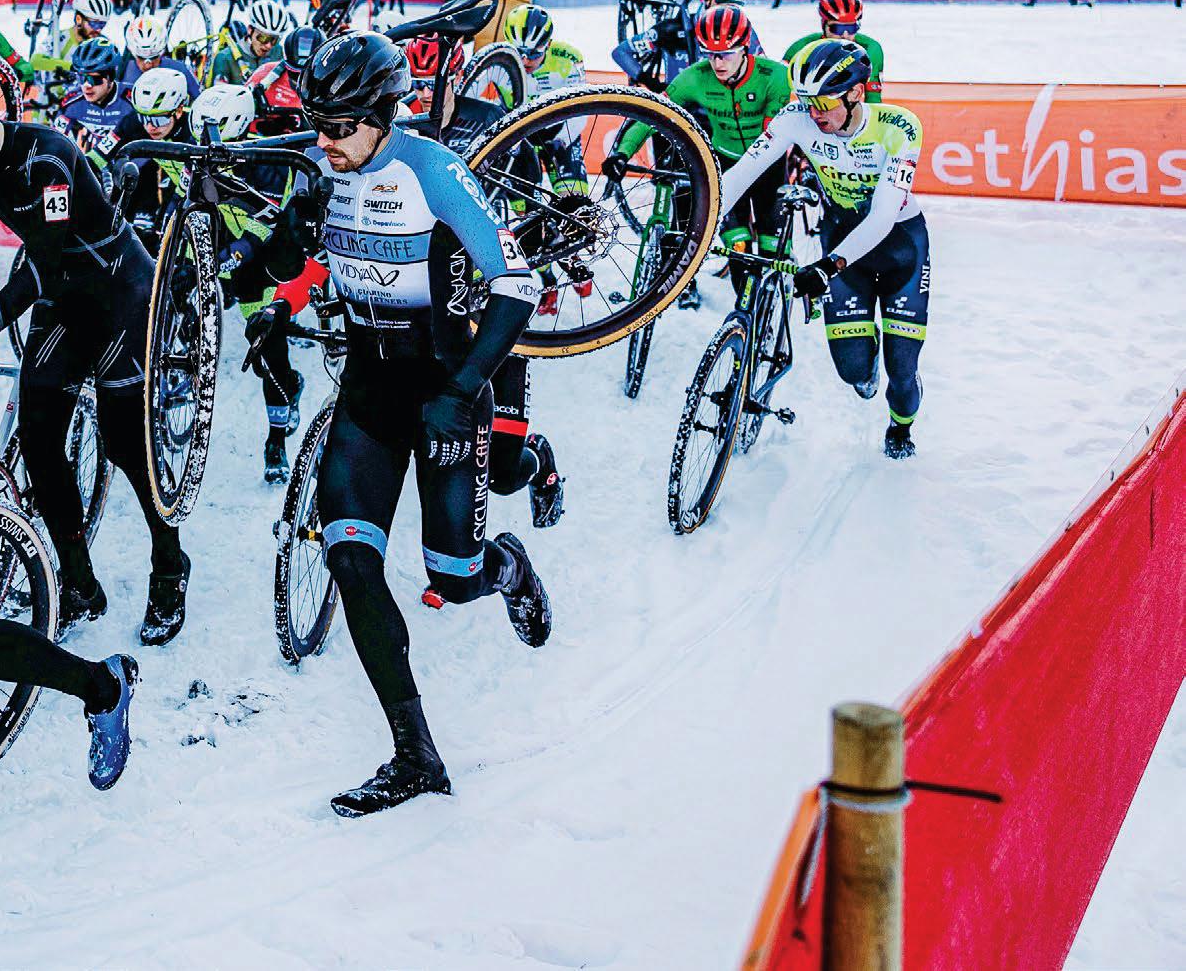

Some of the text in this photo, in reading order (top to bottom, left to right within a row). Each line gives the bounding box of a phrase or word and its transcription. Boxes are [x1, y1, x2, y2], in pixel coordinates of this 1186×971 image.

[877, 110, 918, 143] Wallonie
[931, 84, 1186, 202] ethias
[820, 165, 882, 183] Circus
[899, 169, 913, 184] 16
[45, 196, 68, 214] 43
[363, 199, 404, 210] SWITCH
[372, 239, 416, 259] CAFE
[836, 309, 868, 317] CUBE
[832, 325, 867, 336] Circus
[493, 404, 520, 415] acobi
[473, 424, 489, 542] CYCLING CAFE
[21, 542, 38, 559] DT
